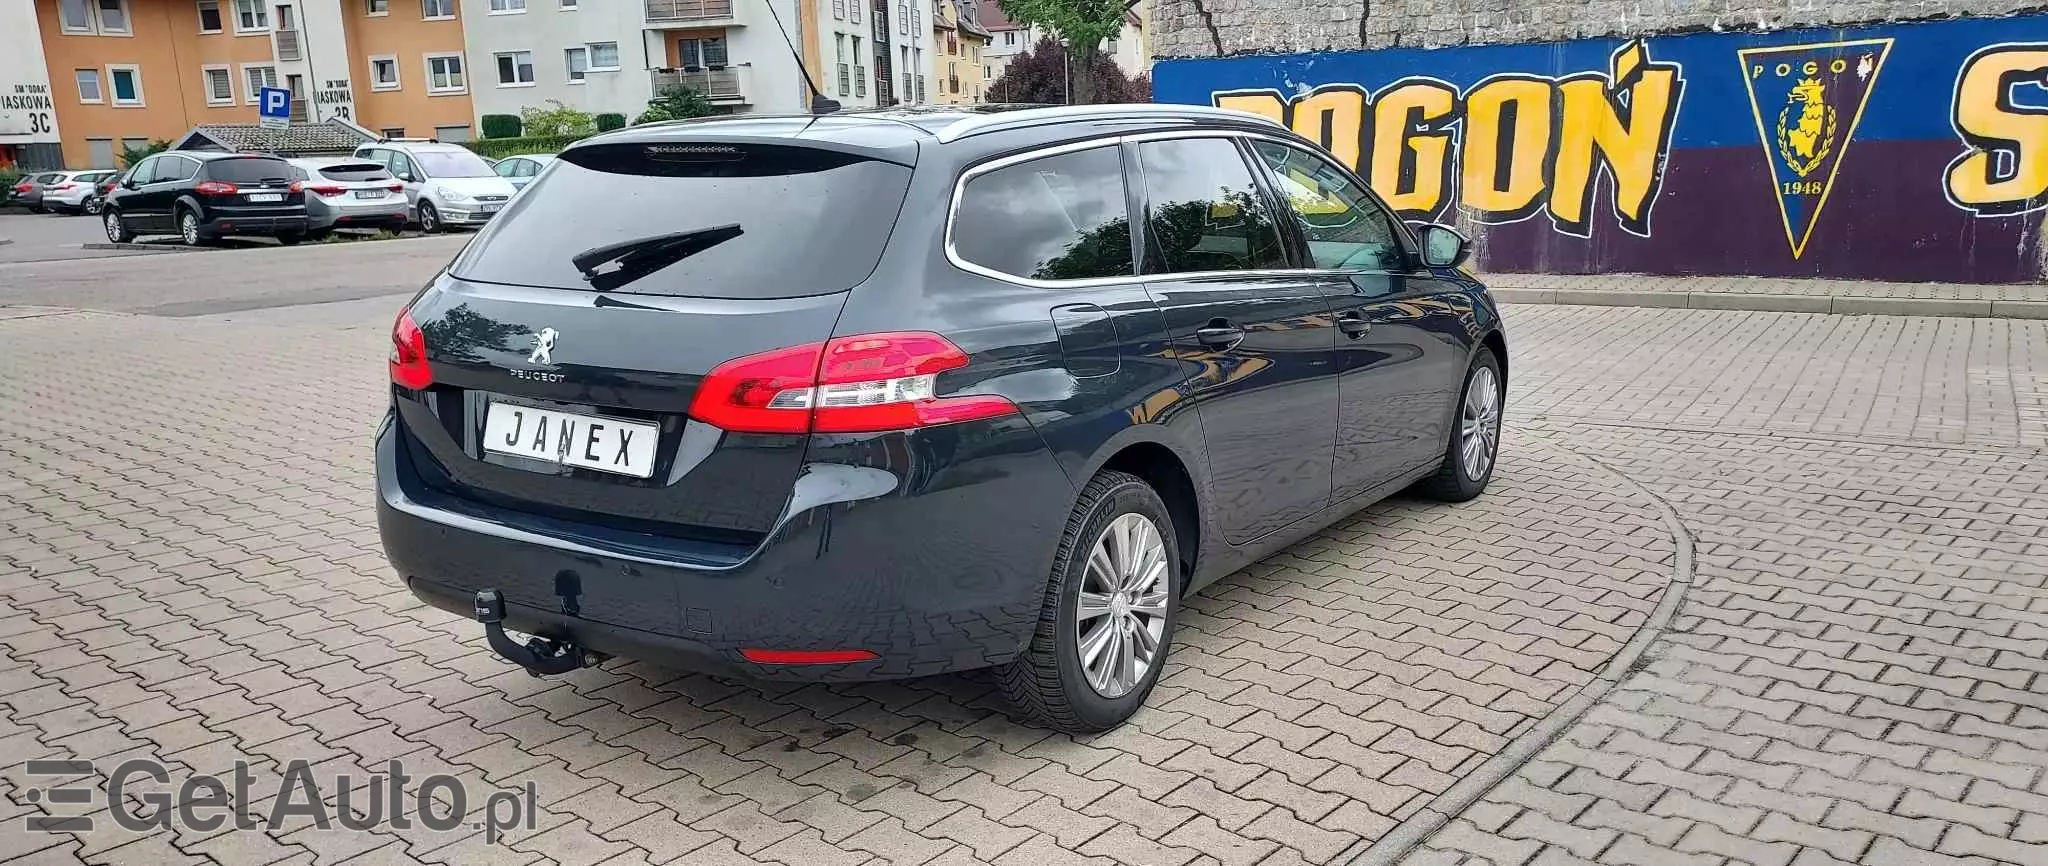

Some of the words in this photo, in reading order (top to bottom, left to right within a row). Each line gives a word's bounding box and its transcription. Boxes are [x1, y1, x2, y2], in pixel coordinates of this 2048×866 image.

[1753, 52, 1874, 80] POGO
[0, 95, 51, 109] IASKOWA
[267, 91, 285, 113] P
[29, 112, 50, 133] 3C
[1783, 180, 1822, 196] 1948
[510, 368, 566, 384] PEUGEOT
[505, 410, 634, 467] JANEX
